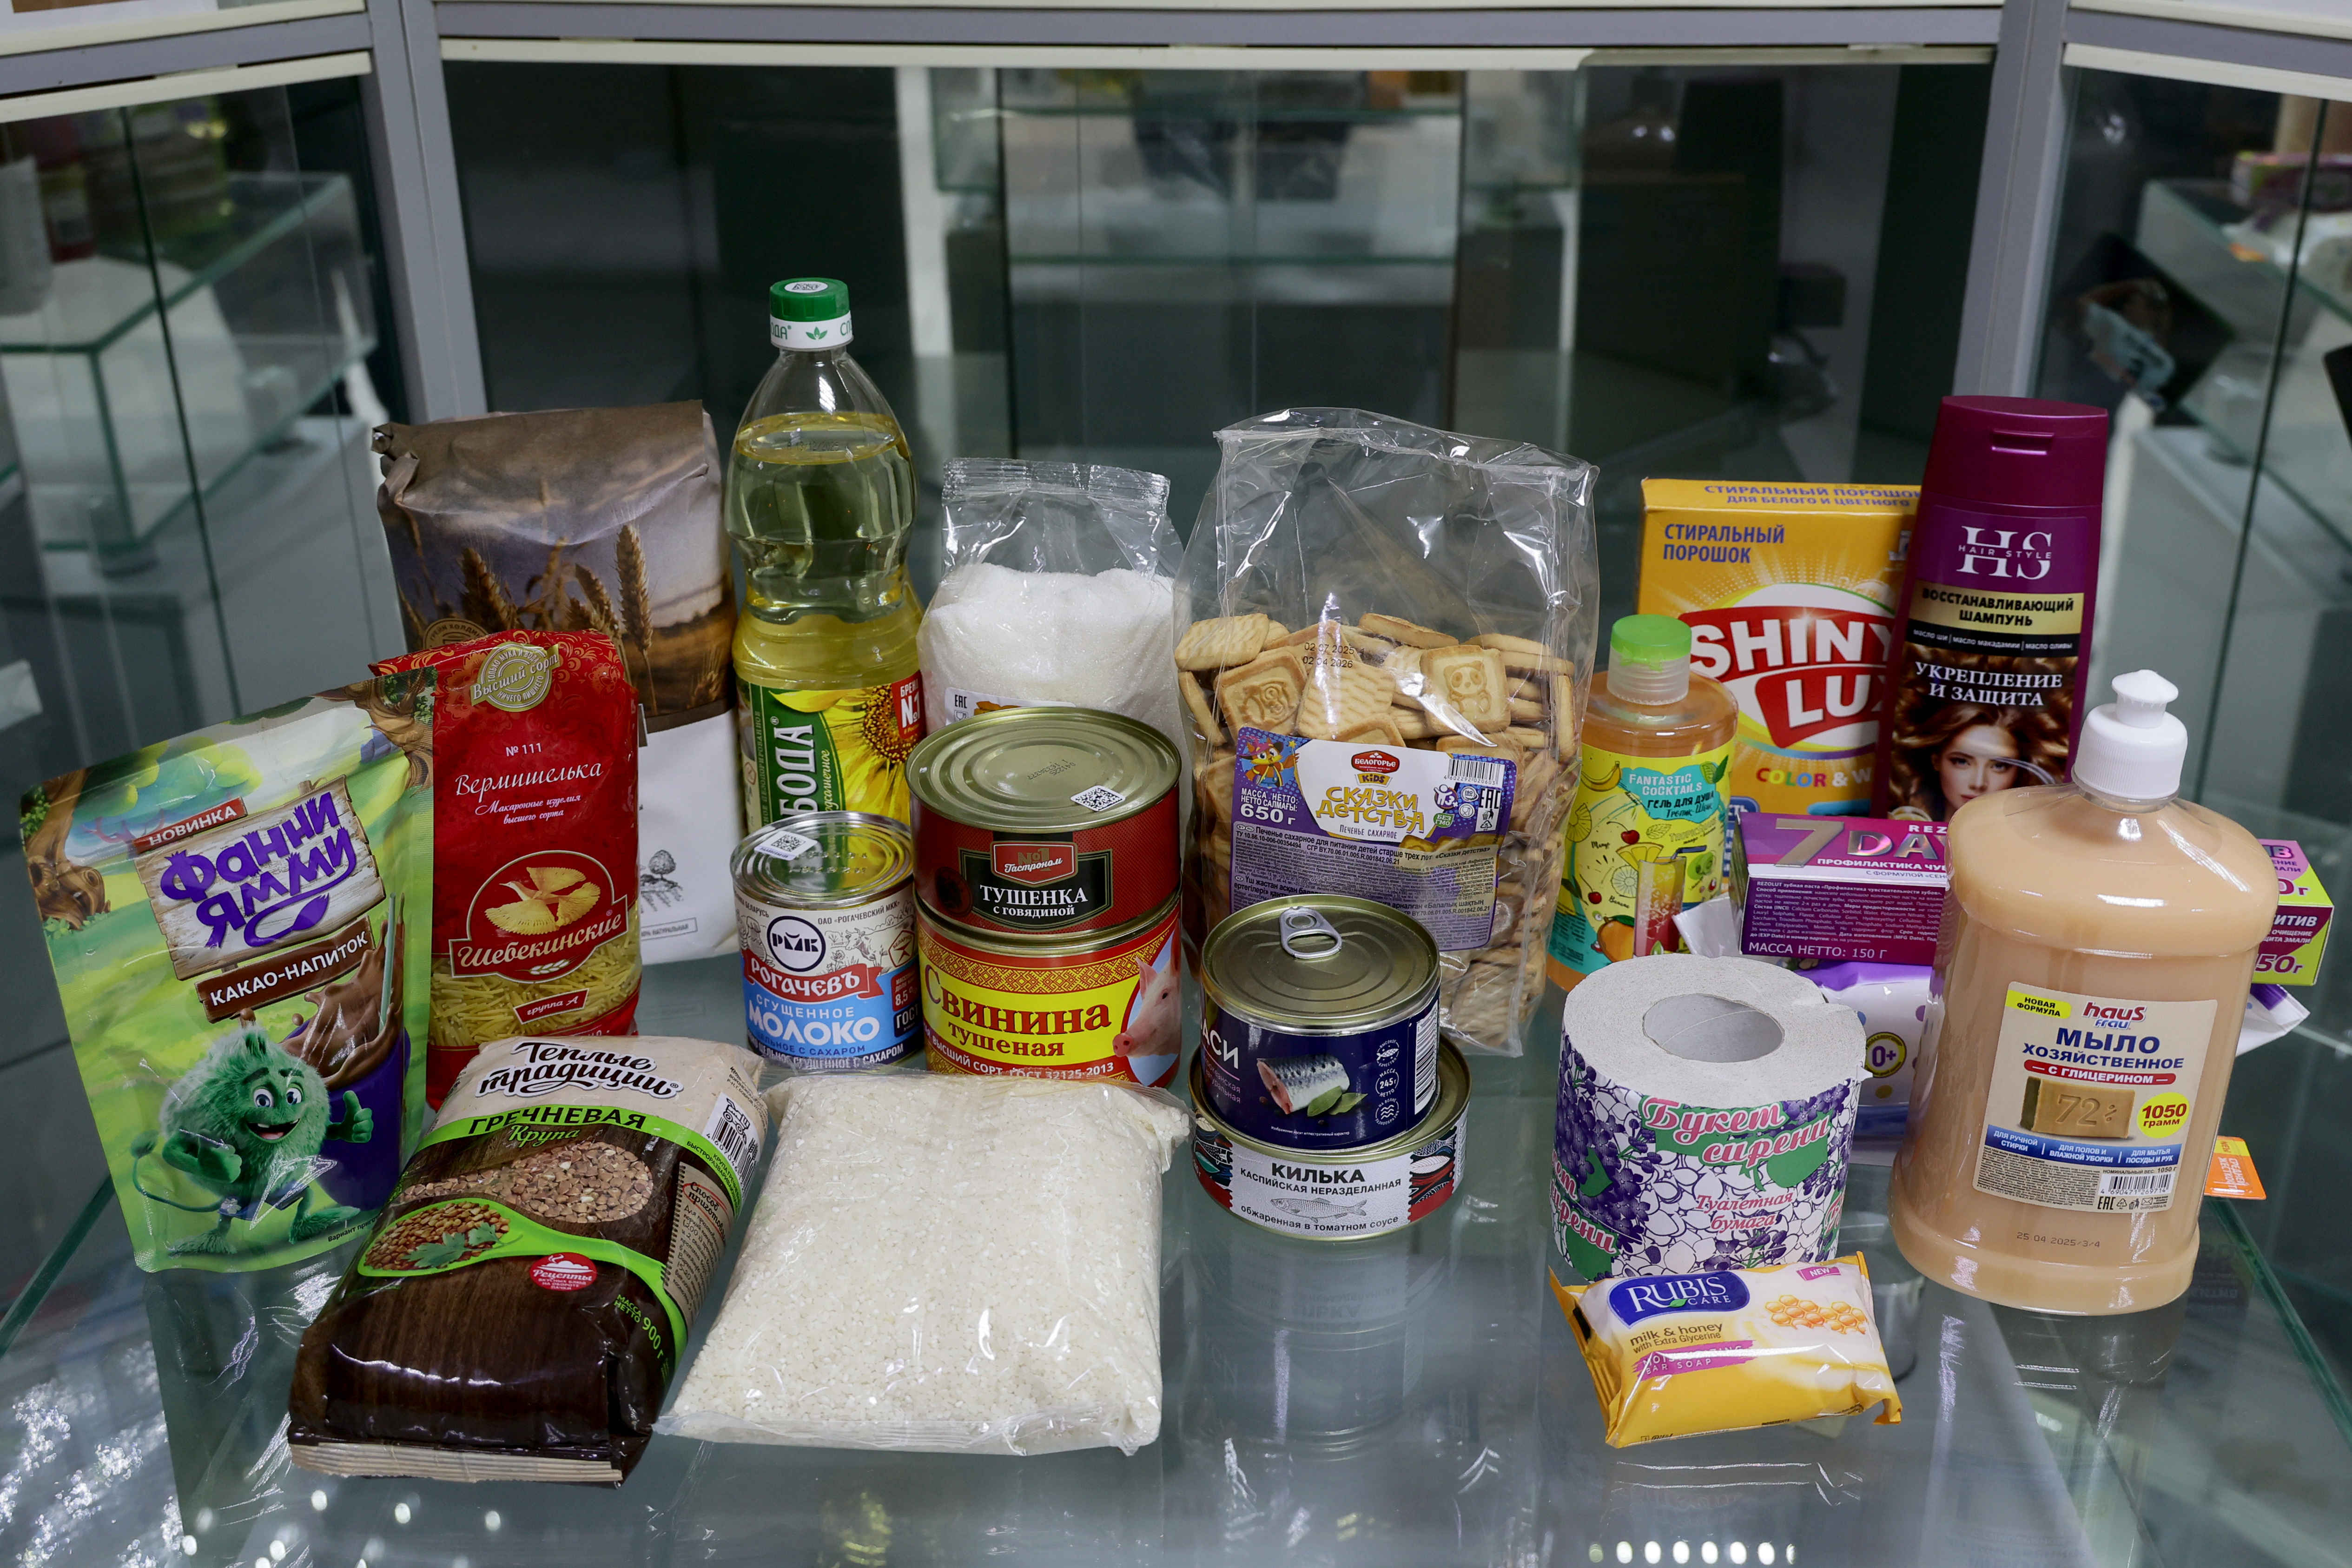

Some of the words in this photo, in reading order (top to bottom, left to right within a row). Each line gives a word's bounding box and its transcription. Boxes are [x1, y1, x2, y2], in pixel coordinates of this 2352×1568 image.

[1705, 485, 1828, 496] СТИРАЛЬНЫЙ
[1762, 496, 1815, 505] БЕЛОГО
[1834, 498, 1910, 507] ЦВЕТНОГО
[1665, 523, 1785, 543] СТИРАЛЬНЫЙ
[1663, 544, 1751, 563] ПОРОШОК
[1956, 526, 2052, 580] HS
[1958, 545, 1995, 556] HAIR
[2005, 550, 2052, 559] STYLE
[1922, 588, 2074, 613] ВОССТАНАВЛИВАЮЩИЙ
[1959, 609, 2033, 626] ШАМПУНЬ
[1913, 629, 1935, 638] масло
[1304, 642, 1315, 651] 02
[1318, 644, 1329, 653] 07
[1332, 645, 1354, 655] 2025
[1303, 656, 1314, 665] 02
[1330, 659, 1353, 668] 2026
[473, 665, 527, 701] Высший
[530, 653, 559, 674] сорт
[1915, 662, 2063, 689] УКРЕПЛЕНИЕ
[1929, 683, 1945, 698] И
[1951, 686, 2044, 706] ЗАЩИТА
[505, 746, 519, 757] №
[522, 742, 542, 754] 111
[1354, 758, 1396, 767] БЕЛОГОРЬЕ
[455, 763, 604, 803] Вермишелька
[1629, 773, 1692, 786] FANTASTIC
[1756, 768, 1826, 787] COLOR
[1241, 787, 1267, 799] МАССА
[1272, 793, 1299, 805] НЕТТО:
[1642, 782, 1703, 795] COCKTAILS
[475, 800, 543, 815] Макаронные
[546, 794, 581, 808] изделия
[1241, 795, 1262, 806] НЕТТО
[1326, 786, 1418, 812] СКАЗКИ
[1647, 799, 1672, 808] ГЕЛЬ
[1673, 797, 1693, 808] ДЛЯ
[1695, 791, 1714, 805] ДУША
[503, 814, 536, 825] высшего
[539, 809, 564, 821] сорта
[1240, 803, 1284, 823] 650
[148, 805, 238, 847] НОВИНКА
[1435, 819, 1451, 827] ГМО
[1244, 832, 1302, 849] 10.86.10-006-00354494
[1255, 827, 1283, 838] Печенье
[1284, 834, 1315, 844] сахарное
[1315, 838, 1329, 847] для
[1330, 841, 1357, 852] питания
[1358, 846, 1378, 854] детей
[1379, 848, 1403, 858] старше
[1461, 847, 1491, 856] детства»
[1368, 829, 1398, 839] САХАРНОЕ
[1004, 857, 1063, 873] Гастроном
[1817, 858, 1923, 871] ПРОФИЛАКТИКА
[1255, 879, 1278, 890] жастан
[979, 884, 1089, 906] ТУШЕНКА
[745, 901, 769, 918] БЕЛАРУСЬ
[1002, 905, 1075, 919] говядиной
[457, 913, 622, 967] Шебекинские
[1749, 942, 1793, 953] МАССА
[1797, 945, 1846, 957] НЕТТО:
[1852, 948, 1875, 958] 150
[210, 931, 369, 1006] КАКАО-НАПИТОК
[527, 1000, 563, 1016] группа
[756, 994, 854, 1019] СГУЩЕННОЕ
[924, 964, 1112, 1035] Свинина
[2024, 996, 2056, 1008] НОВАЯ
[2016, 1002, 2061, 1017] ФОРМУЛА
[749, 999, 880, 1046] МОЛОКО
[2094, 1019, 2130, 1029] frau
[948, 1021, 1065, 1057] тушеная
[2056, 1027, 2160, 1054] МЫЛО
[512, 1042, 652, 1070] Теплые
[809, 1045, 865, 1056] САХАРОМ
[863, 1043, 904, 1064] САХАРОМ
[932, 1035, 971, 1068] ВЫСШИЙ
[1872, 1045, 1896, 1067] 0+
[2022, 1042, 2185, 1069] ХОЗЯЙСТВЕННОЕ
[480, 1063, 672, 1095] традиции
[1379, 1068, 1396, 1078] МАССА
[2061, 1068, 2154, 1084] ГЛИЦЕРИНОМ
[1379, 1088, 1395, 1098] НЕТТО
[2142, 1103, 2187, 1119] 1050
[468, 1107, 647, 1134] ГРЕЧНЕВАЯ
[1644, 1098, 1786, 1144] Букет
[2143, 1118, 2180, 1128] грамм
[509, 1124, 581, 1148] Крупа
[1702, 1116, 1831, 1167] сирени
[1994, 1131, 2009, 1139] ДЛЯ
[2009, 1132, 2038, 1146] РУЧНОЙ
[2001, 1140, 2028, 1152] СТИРКИ
[2058, 1144, 2075, 1153] ДЛЯ
[2077, 1146, 2100, 1155] ПОЛОВ
[2049, 1149, 2085, 1161] ВЛАЖНОЙ
[2086, 1154, 2114, 1163] УБОРКИ
[2126, 1156, 2154, 1164] ПОСУДЫ
[1240, 1167, 1307, 1193] КАСПИЙСКАЯ
[1311, 1178, 1401, 1196] НЕРАЗДЕЛАННАЯ
[1271, 1163, 1365, 1184] КИЛЬКА
[1695, 1191, 1794, 1213] Туалетная
[1241, 1205, 1301, 1229] обжаренная
[1315, 1223, 1366, 1231] томатном
[1370, 1216, 1399, 1229] соусе
[1711, 1215, 1777, 1233] бумага
[327, 1225, 356, 1242] Вариант
[533, 1269, 593, 1282] Рецепты
[1810, 1267, 1830, 1277] NEW
[1625, 1276, 1727, 1313] RUBIS
[1687, 1295, 1731, 1306] CARE
[616, 1294, 642, 1317] МАССА
[614, 1300, 641, 1323] НЕТТО
[642, 1317, 661, 1350] 900
[1630, 1331, 1659, 1346] milk
[1664, 1327, 1675, 1336] &
[1678, 1323, 1724, 1338] honey
[1633, 1341, 1652, 1354] with
[1654, 1336, 1677, 1347] Extra
[1678, 1332, 1722, 1344] Glycerine
[1646, 1363, 1668, 1375] BAR
[1677, 1358, 1712, 1369] SOAP
